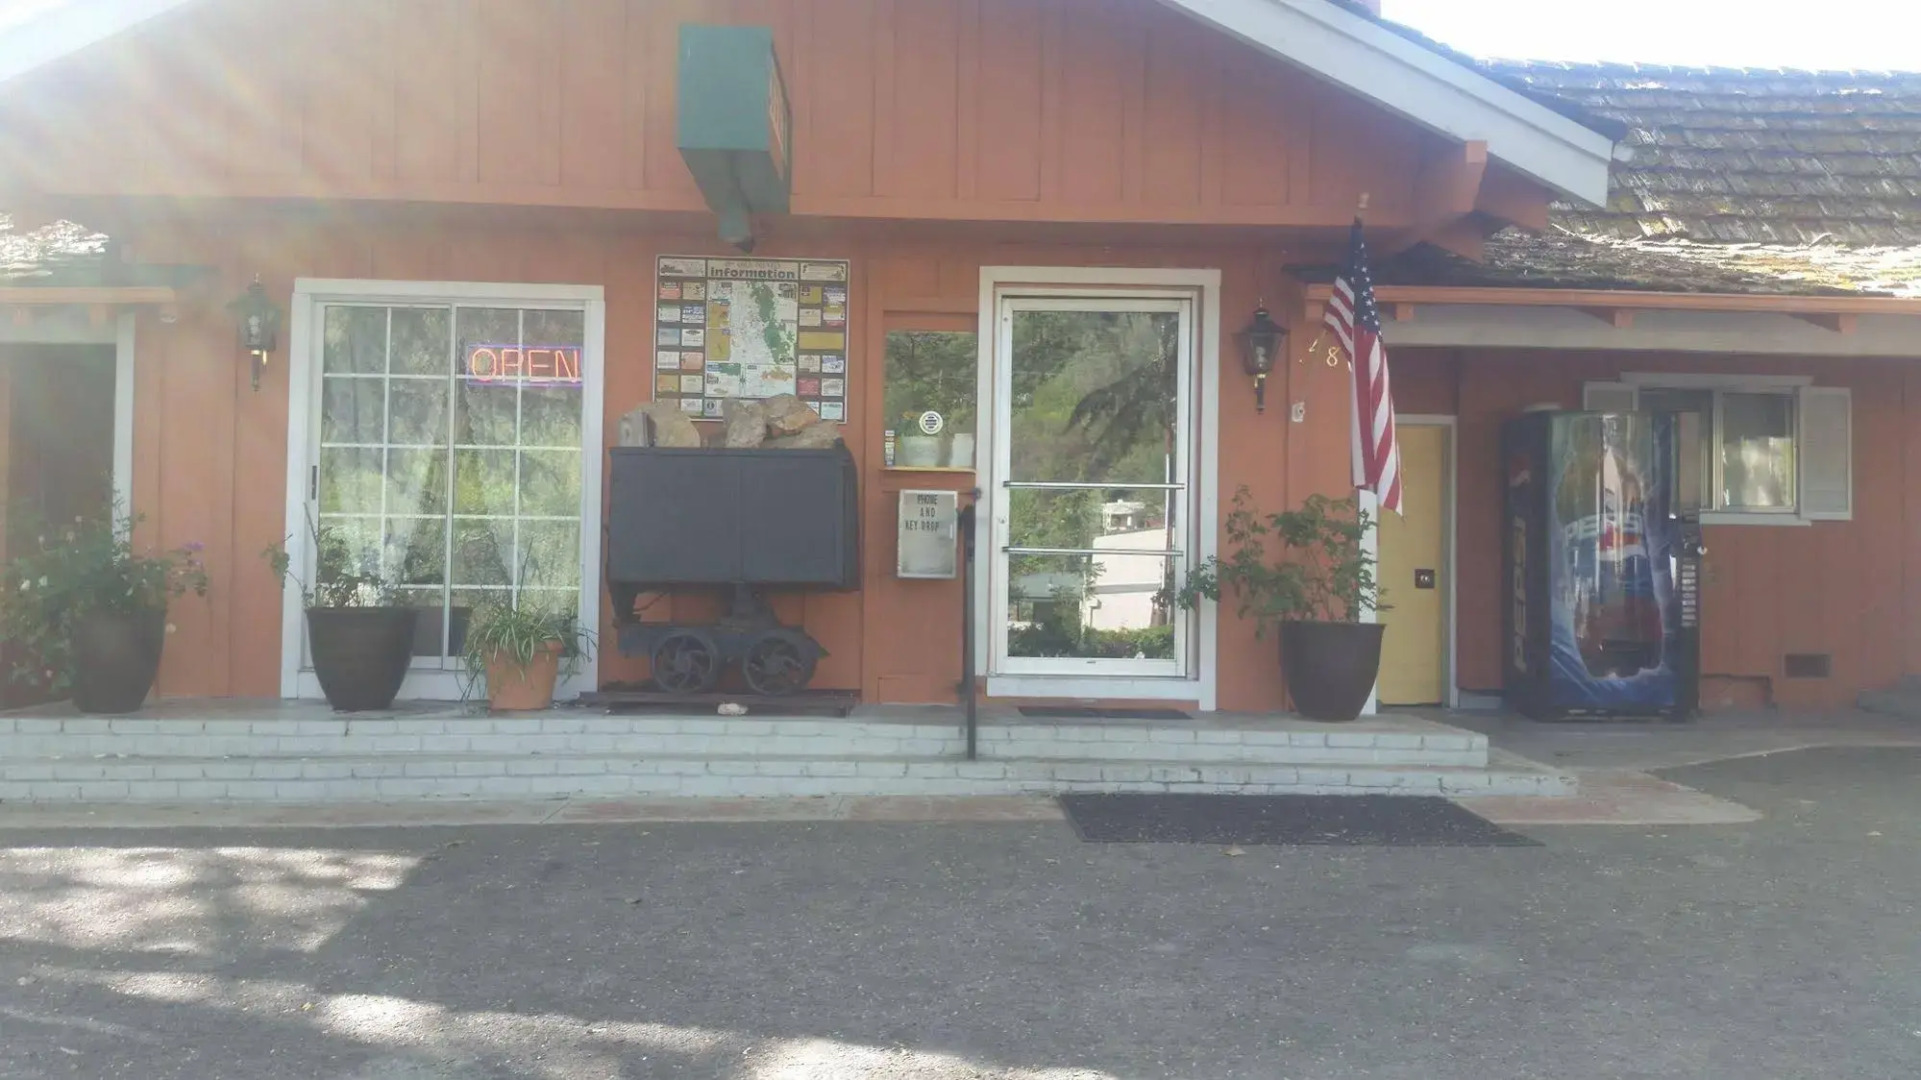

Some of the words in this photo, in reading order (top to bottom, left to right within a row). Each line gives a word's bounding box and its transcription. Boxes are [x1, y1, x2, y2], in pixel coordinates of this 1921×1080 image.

[472, 348, 578, 383] OPEN
[917, 494, 938, 505] PHONE
[920, 507, 936, 517] AND
[905, 520, 918, 531] KEY
[921, 521, 940, 532] DROP
